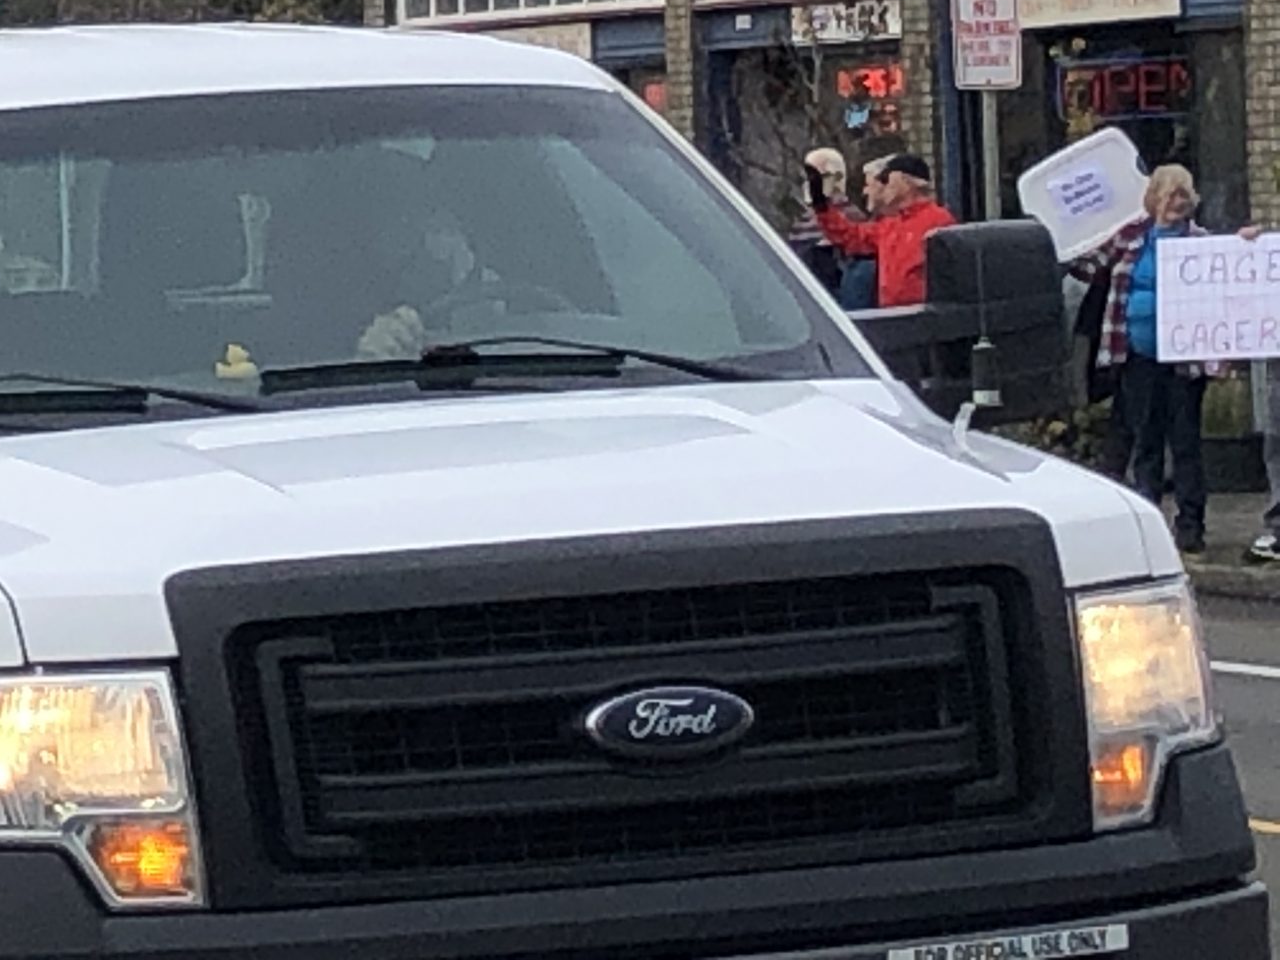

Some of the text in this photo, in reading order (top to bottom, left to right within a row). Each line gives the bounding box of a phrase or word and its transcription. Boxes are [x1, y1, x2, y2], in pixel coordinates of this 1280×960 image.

[1065, 64, 1192, 113] OPEN
[1179, 249, 1280, 286] CAGE
[1170, 317, 1280, 355] CAGER
[629, 698, 716, 739] Ford
[1032, 932, 1062, 956] USE
[1067, 928, 1107, 953] ONLY
